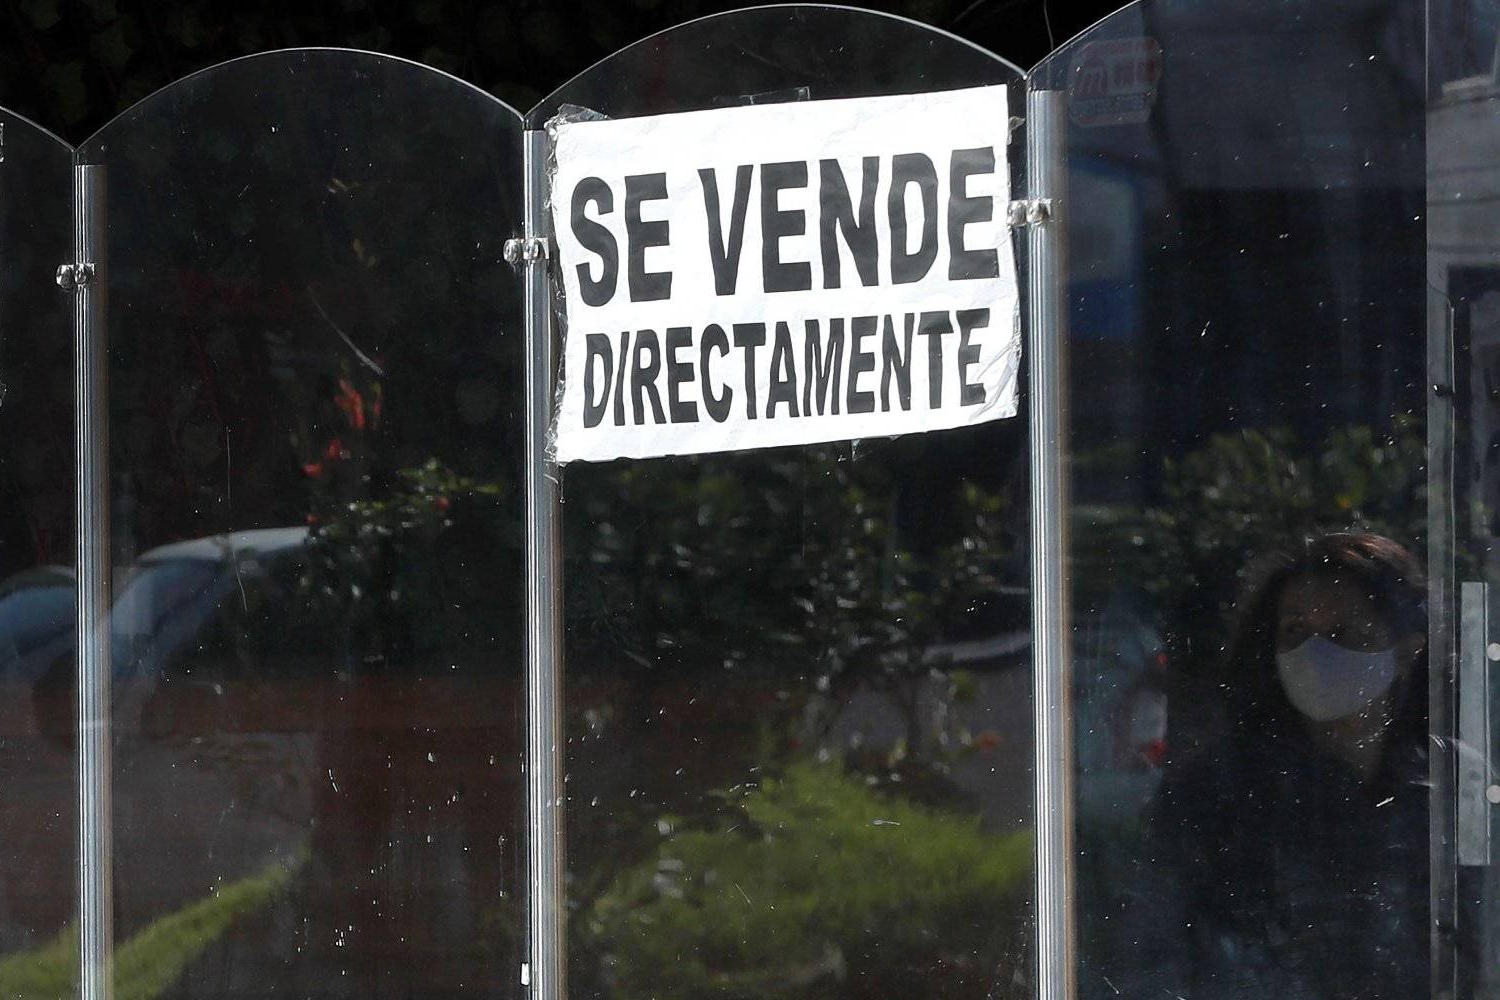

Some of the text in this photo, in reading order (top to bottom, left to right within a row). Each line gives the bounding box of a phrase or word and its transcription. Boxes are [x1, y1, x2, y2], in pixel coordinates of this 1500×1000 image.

[570, 145, 1000, 308] SE VENDE
[582, 307, 991, 429] DIRECTAMENTE
